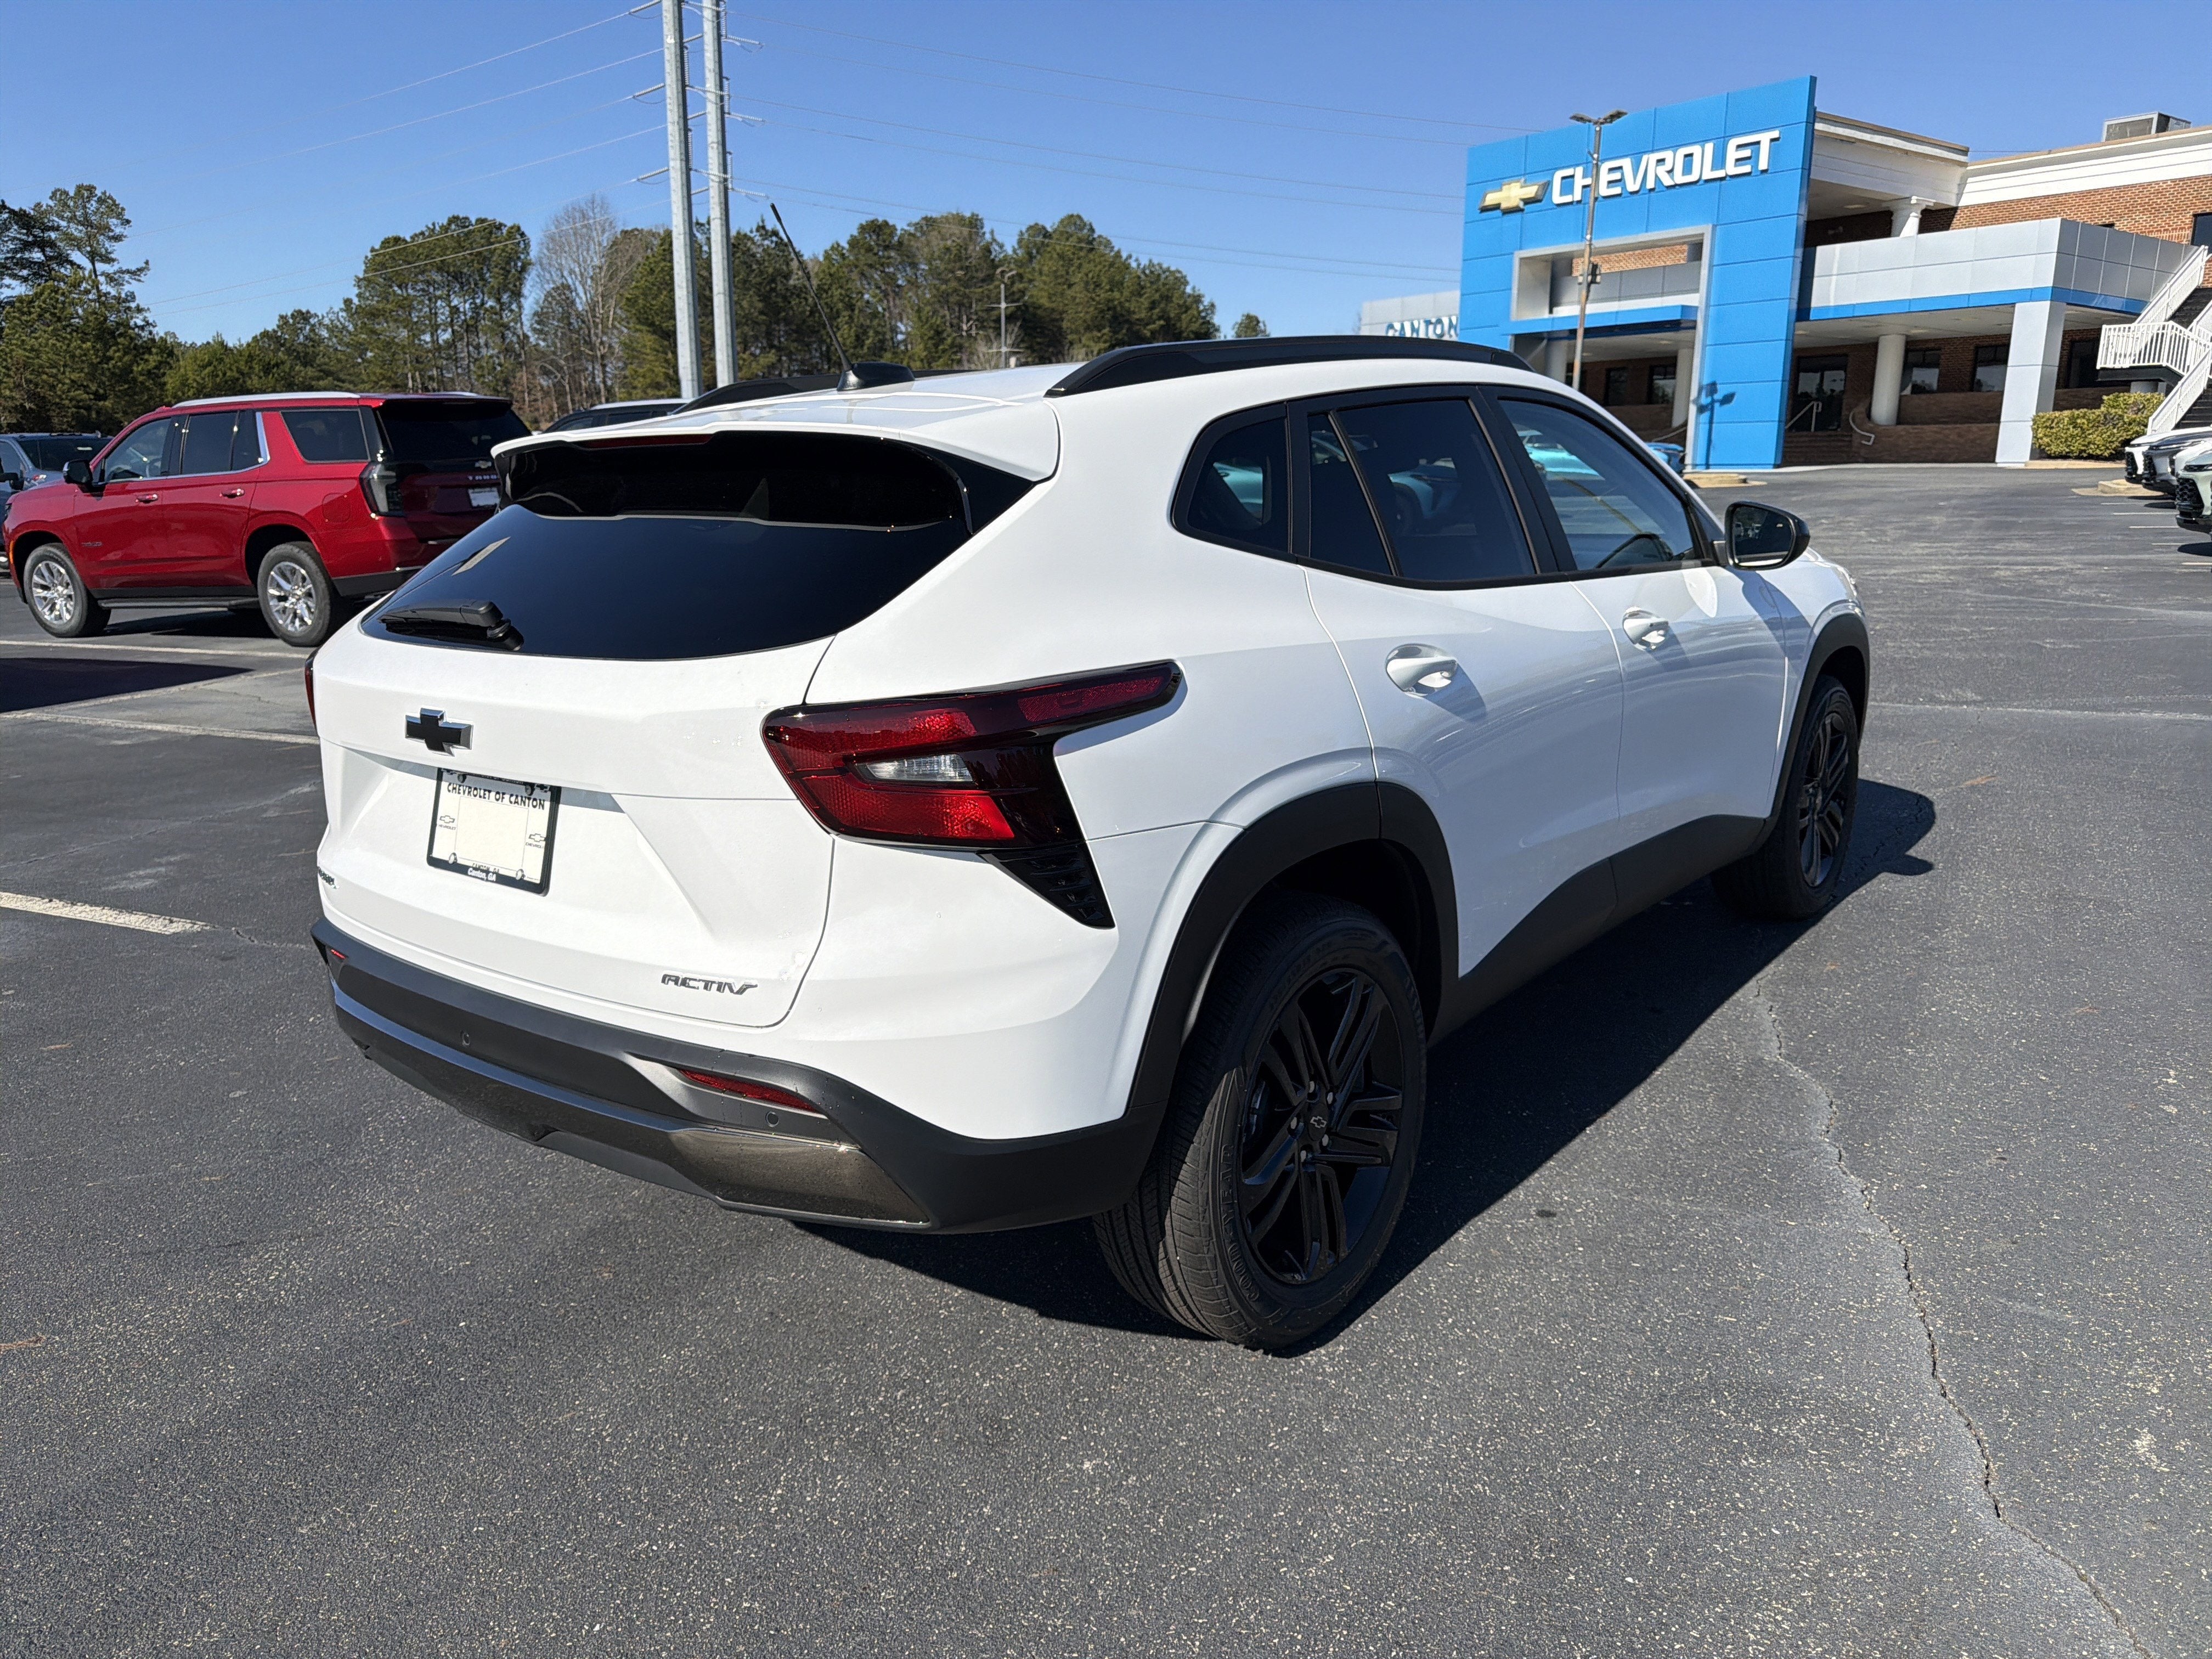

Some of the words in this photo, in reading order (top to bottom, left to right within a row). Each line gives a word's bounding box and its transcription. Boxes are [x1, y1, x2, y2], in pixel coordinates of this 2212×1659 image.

[1551, 129, 1780, 206] CHEVROLET
[1386, 315, 1459, 338] CANTON
[447, 782, 492, 800] CHEVROLET
[495, 791, 506, 803] OF
[509, 794, 545, 810] CANTON
[661, 972, 758, 995] ACTIV
